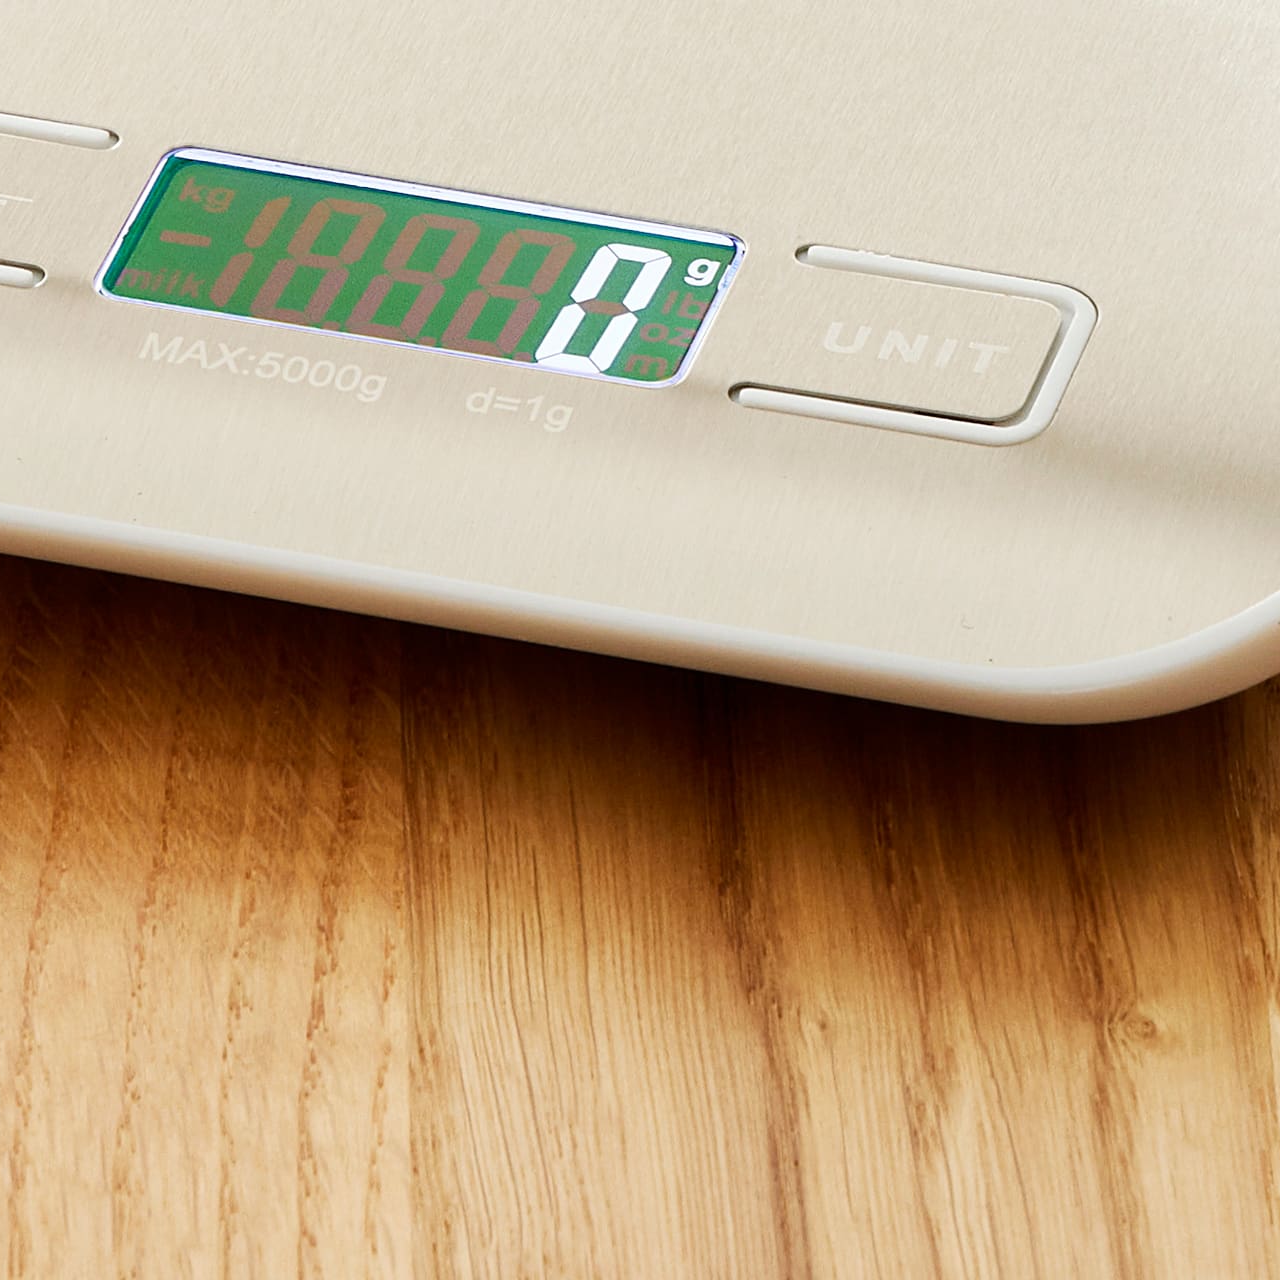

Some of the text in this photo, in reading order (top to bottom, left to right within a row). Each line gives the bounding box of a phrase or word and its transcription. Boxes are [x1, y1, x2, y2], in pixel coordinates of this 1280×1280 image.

[179, 177, 236, 213] kg
[683, 257, 721, 287] g
[822, 321, 1009, 375] UNIT
[138, 332, 574, 433] MAX:5000g d=1g
